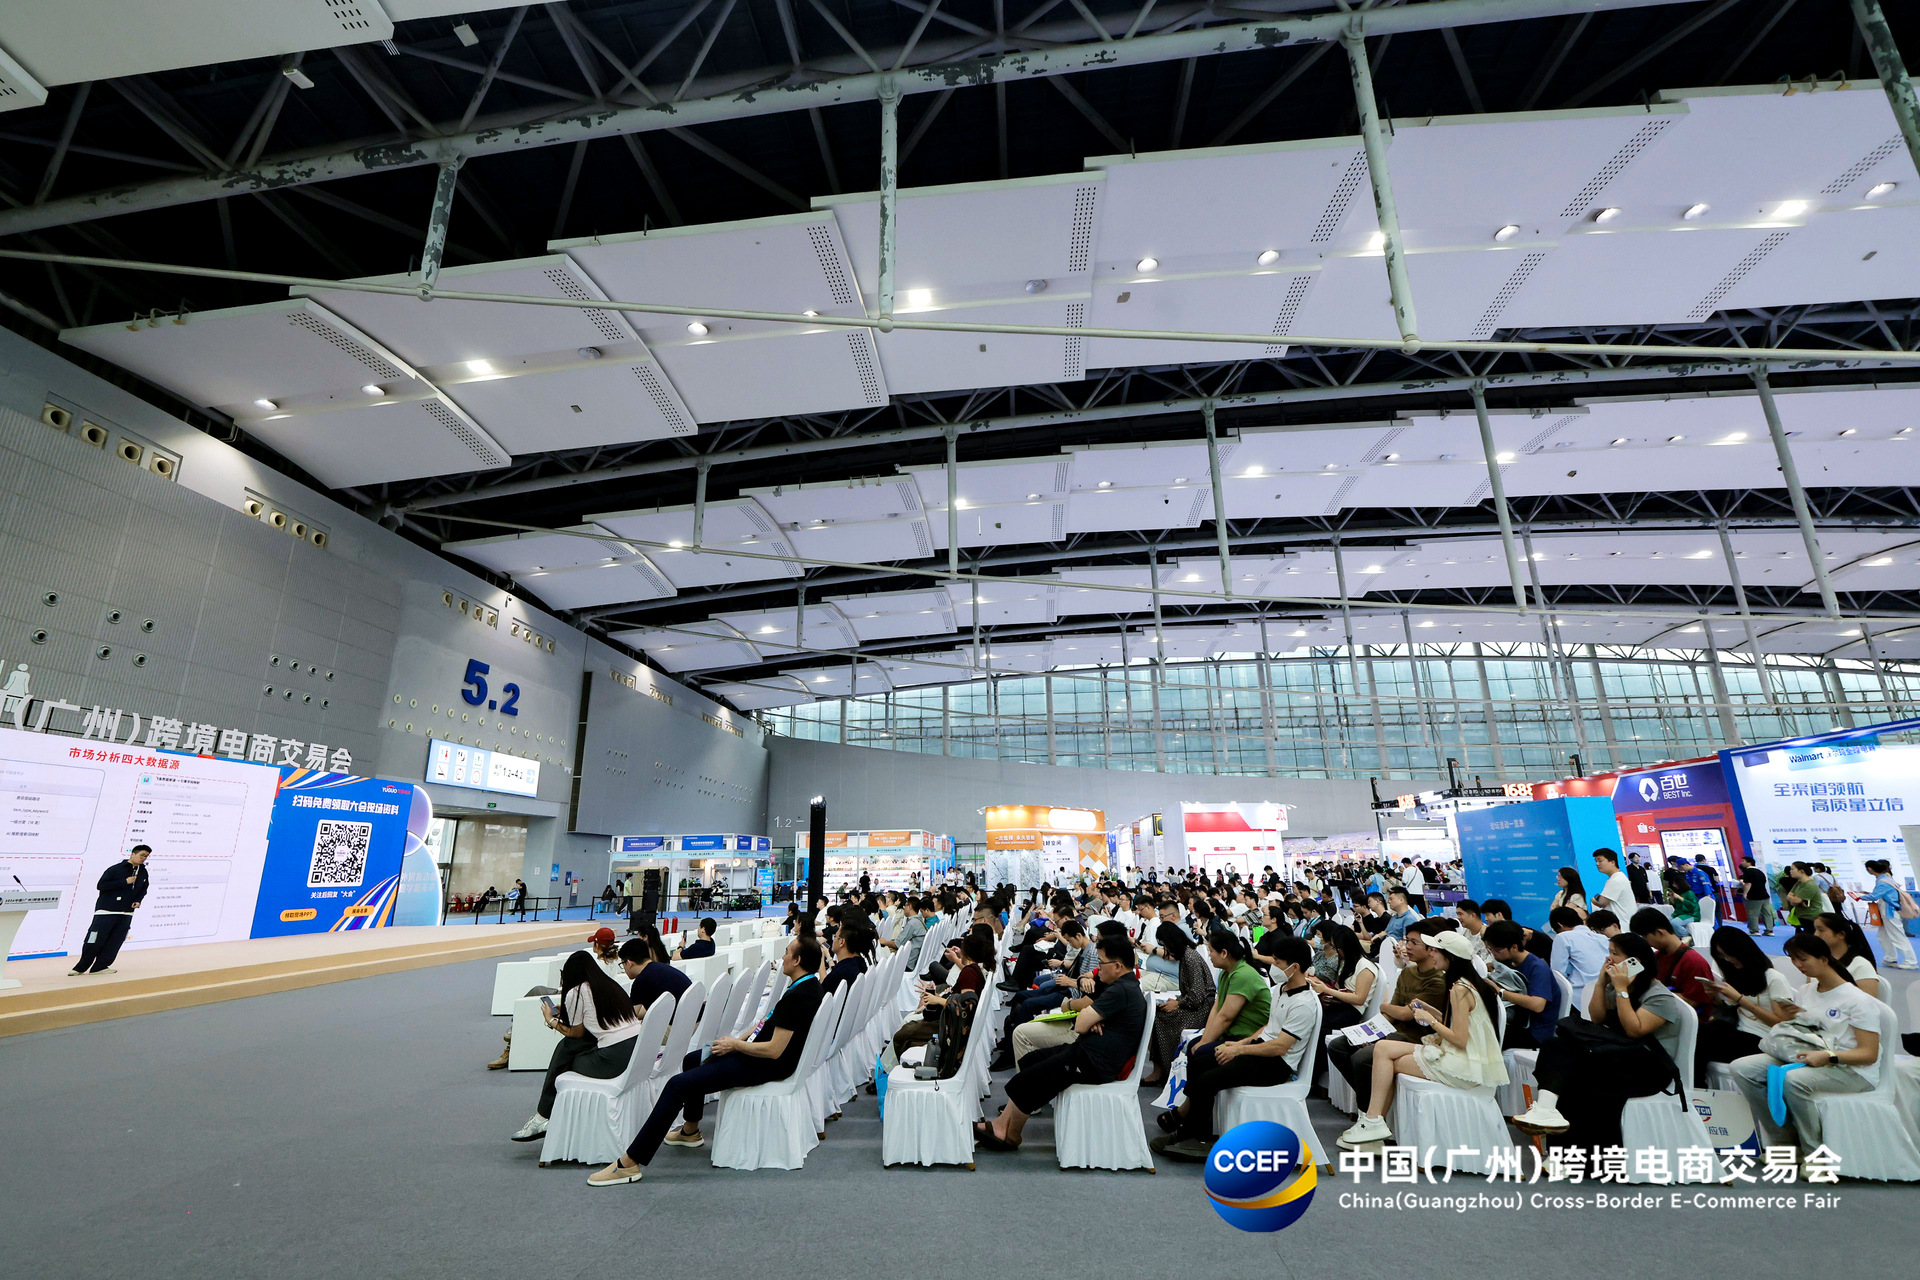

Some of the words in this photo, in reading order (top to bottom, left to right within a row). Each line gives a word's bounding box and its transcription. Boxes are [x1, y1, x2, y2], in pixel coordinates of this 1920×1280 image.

[461, 658, 520, 716] 5.2
[69, 747, 181, 770] 市场分析四大数据源
[1789, 752, 1824, 763] Walmart
[1659, 773, 1689, 791] 百世
[1774, 782, 1865, 797] 全渠道领航
[1663, 790, 1680, 799] BEST
[1681, 790, 1693, 798] Inc.
[1811, 798, 1904, 812] 高质量立信
